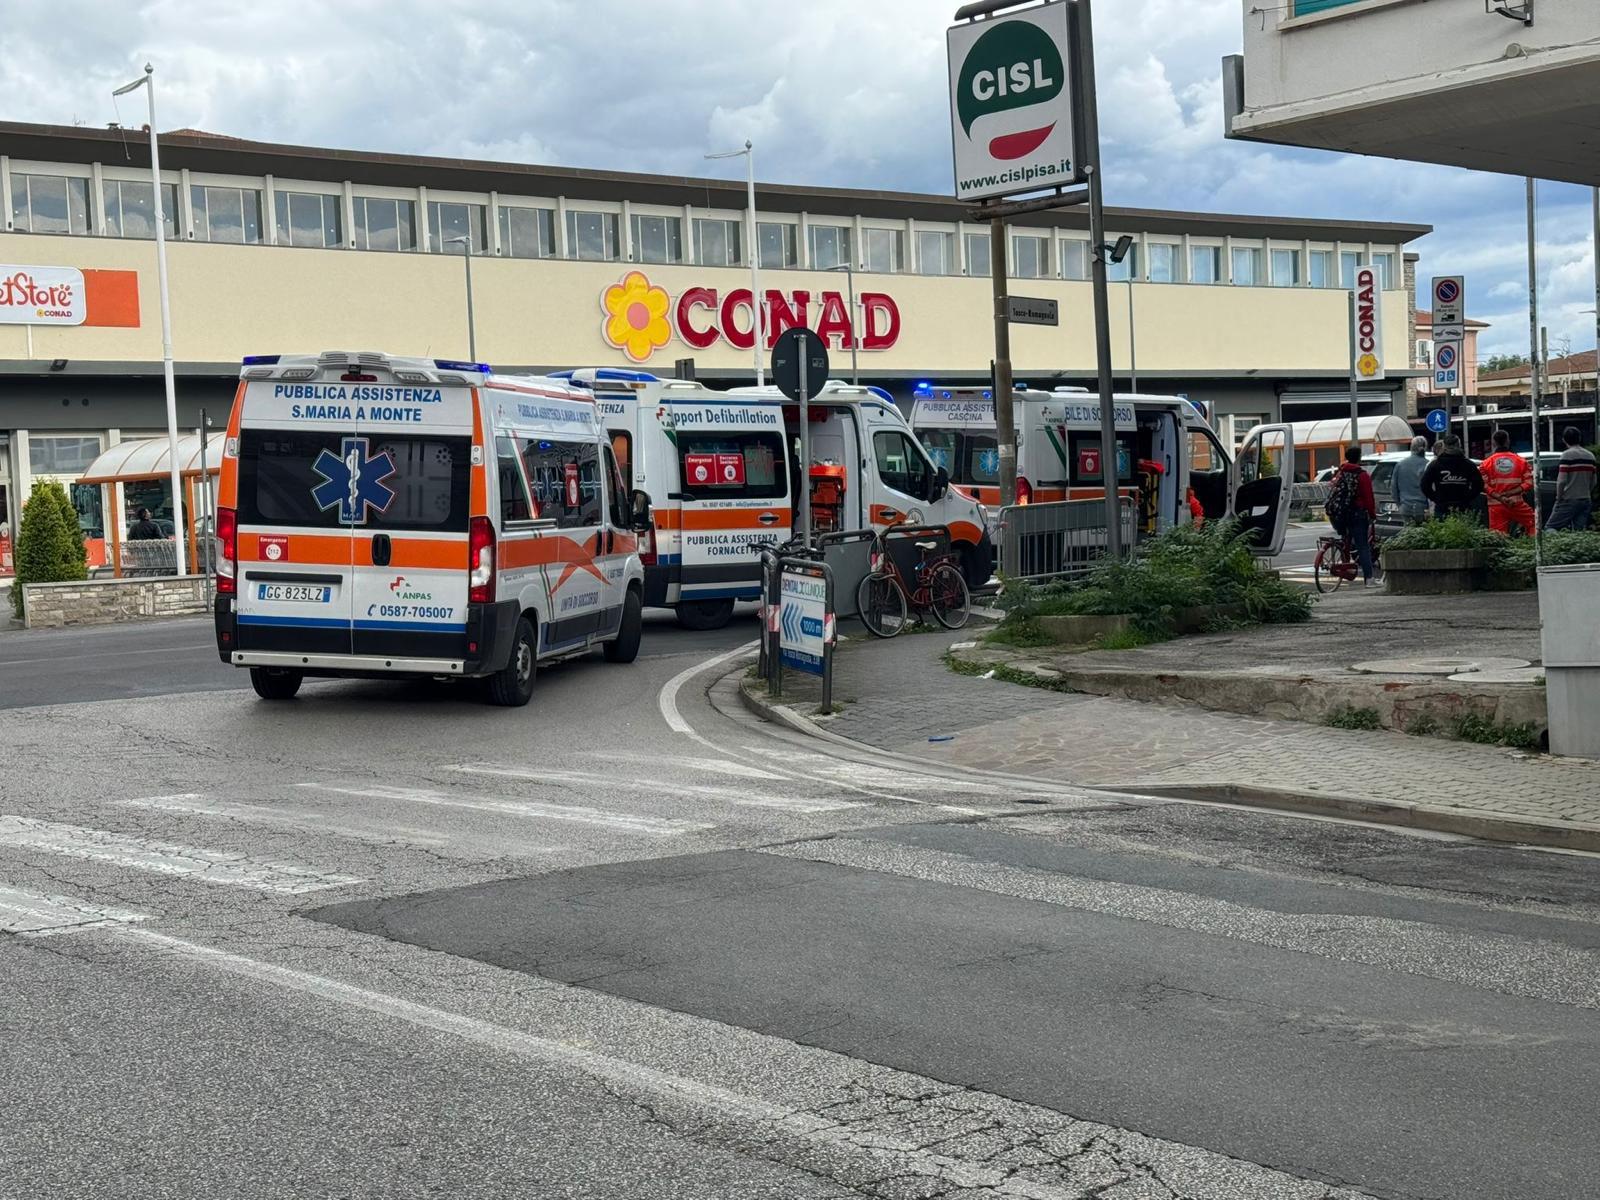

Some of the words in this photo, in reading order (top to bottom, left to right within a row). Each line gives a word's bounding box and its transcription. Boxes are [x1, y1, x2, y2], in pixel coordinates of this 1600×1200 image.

[972, 58, 1053, 101] CISL
[960, 158, 1071, 191] www.cislpisa.it
[44, 310, 72, 318] CONAD
[677, 286, 901, 351] CONAD
[1358, 270, 1375, 353] CONAD
[274, 384, 347, 400] PUBBLICA
[351, 386, 442, 403] ASSISTENZA
[291, 404, 350, 420] S.MARIA
[355, 406, 367, 420] A
[370, 407, 423, 422] MONTE
[705, 408, 777, 425] Defibrillation
[922, 403, 961, 413] PUBBLICA
[947, 412, 983, 422] CASCINA
[687, 535, 729, 545] PUBBLICA
[731, 533, 778, 544] ASSISTENZA
[402, 592, 432, 600] ANPAS
[380, 605, 454, 619] 0587-705007
